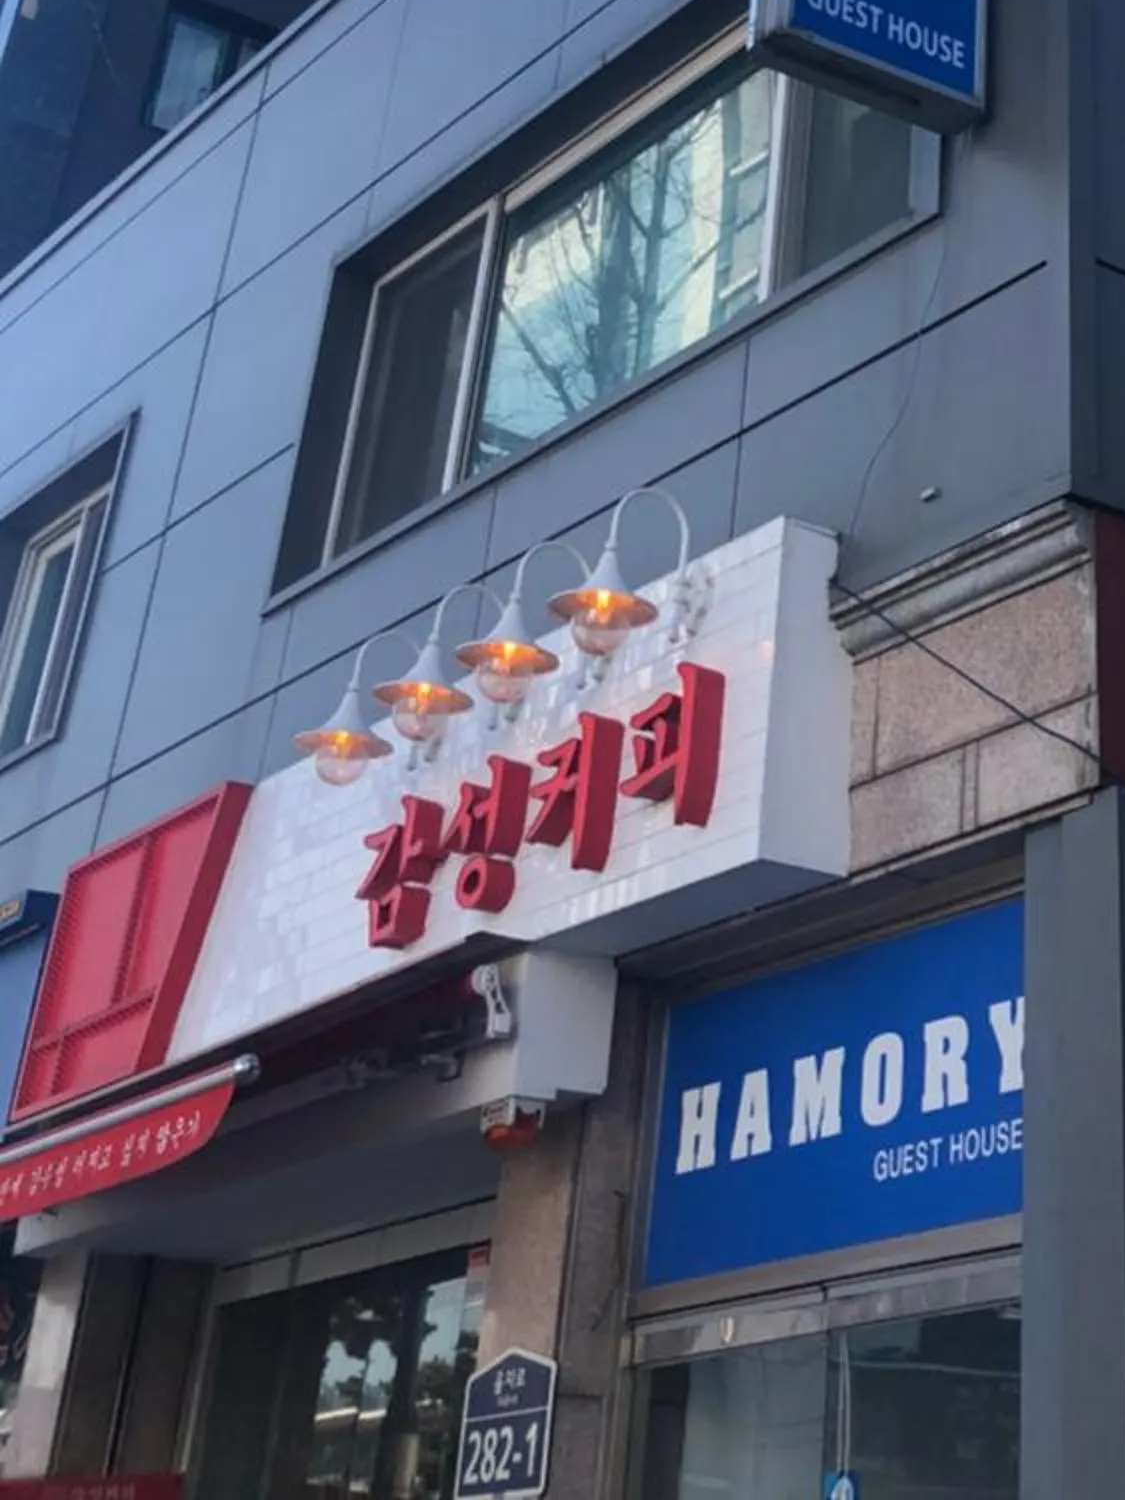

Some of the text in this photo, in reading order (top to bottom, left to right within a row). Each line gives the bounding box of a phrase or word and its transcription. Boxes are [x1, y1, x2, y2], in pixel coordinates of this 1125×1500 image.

[887, 12, 966, 69] HOUSE
[355, 662, 726, 949] 감성커피
[675, 996, 1024, 1174] HAMORY
[873, 1118, 1024, 1183] GUEST HOUSE
[462, 1420, 539, 1486] 282-1
